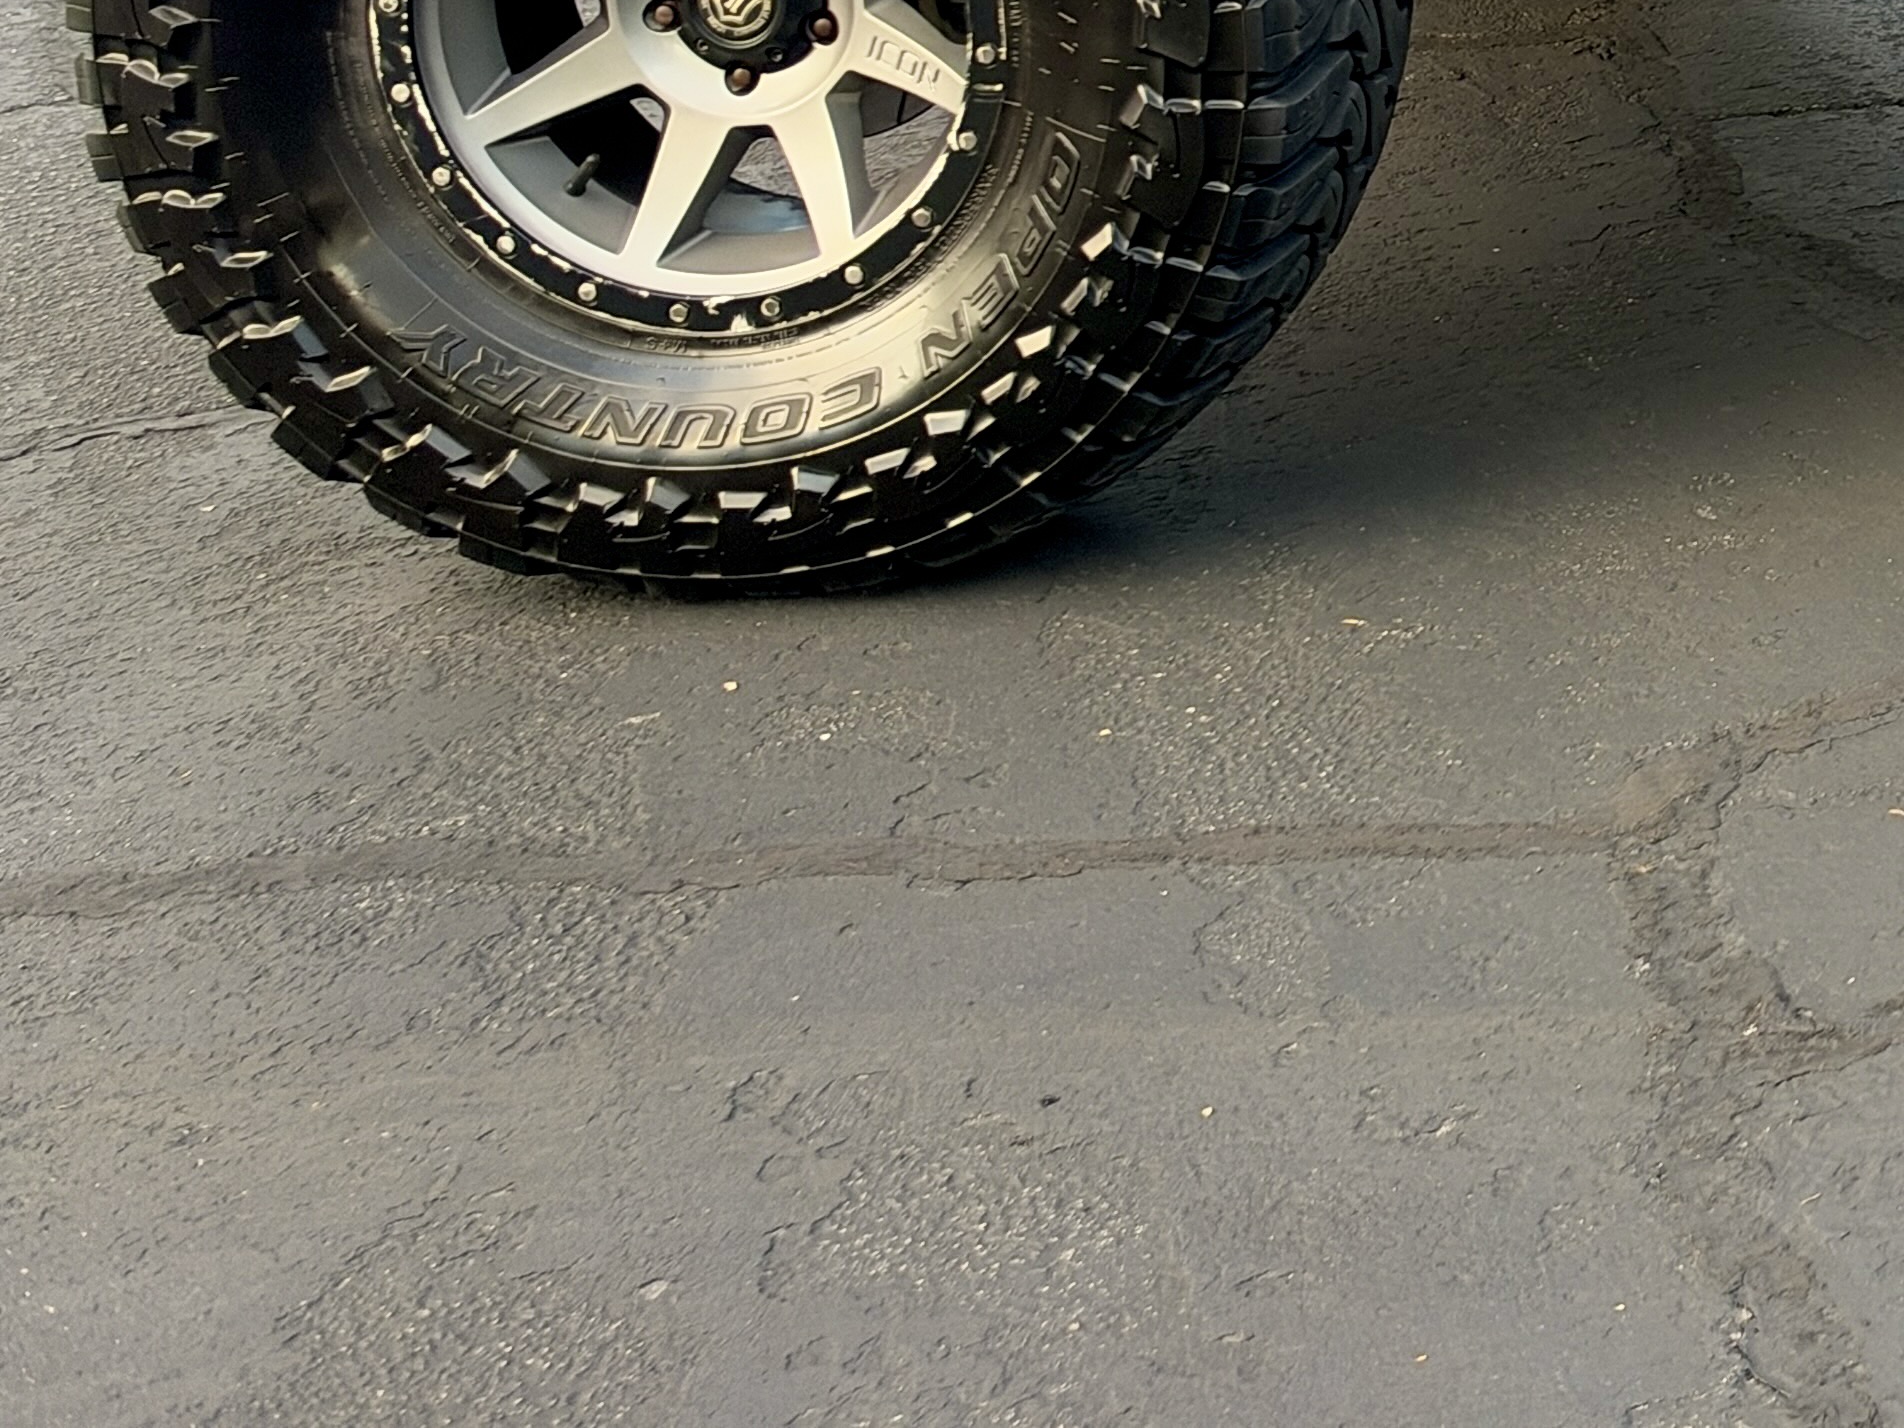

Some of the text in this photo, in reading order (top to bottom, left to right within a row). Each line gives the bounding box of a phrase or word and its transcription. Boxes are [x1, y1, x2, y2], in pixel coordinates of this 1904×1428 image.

[865, 35, 941, 92] ICON
[917, 131, 1080, 378] OPEN
[387, 324, 883, 449] COUNTRY
